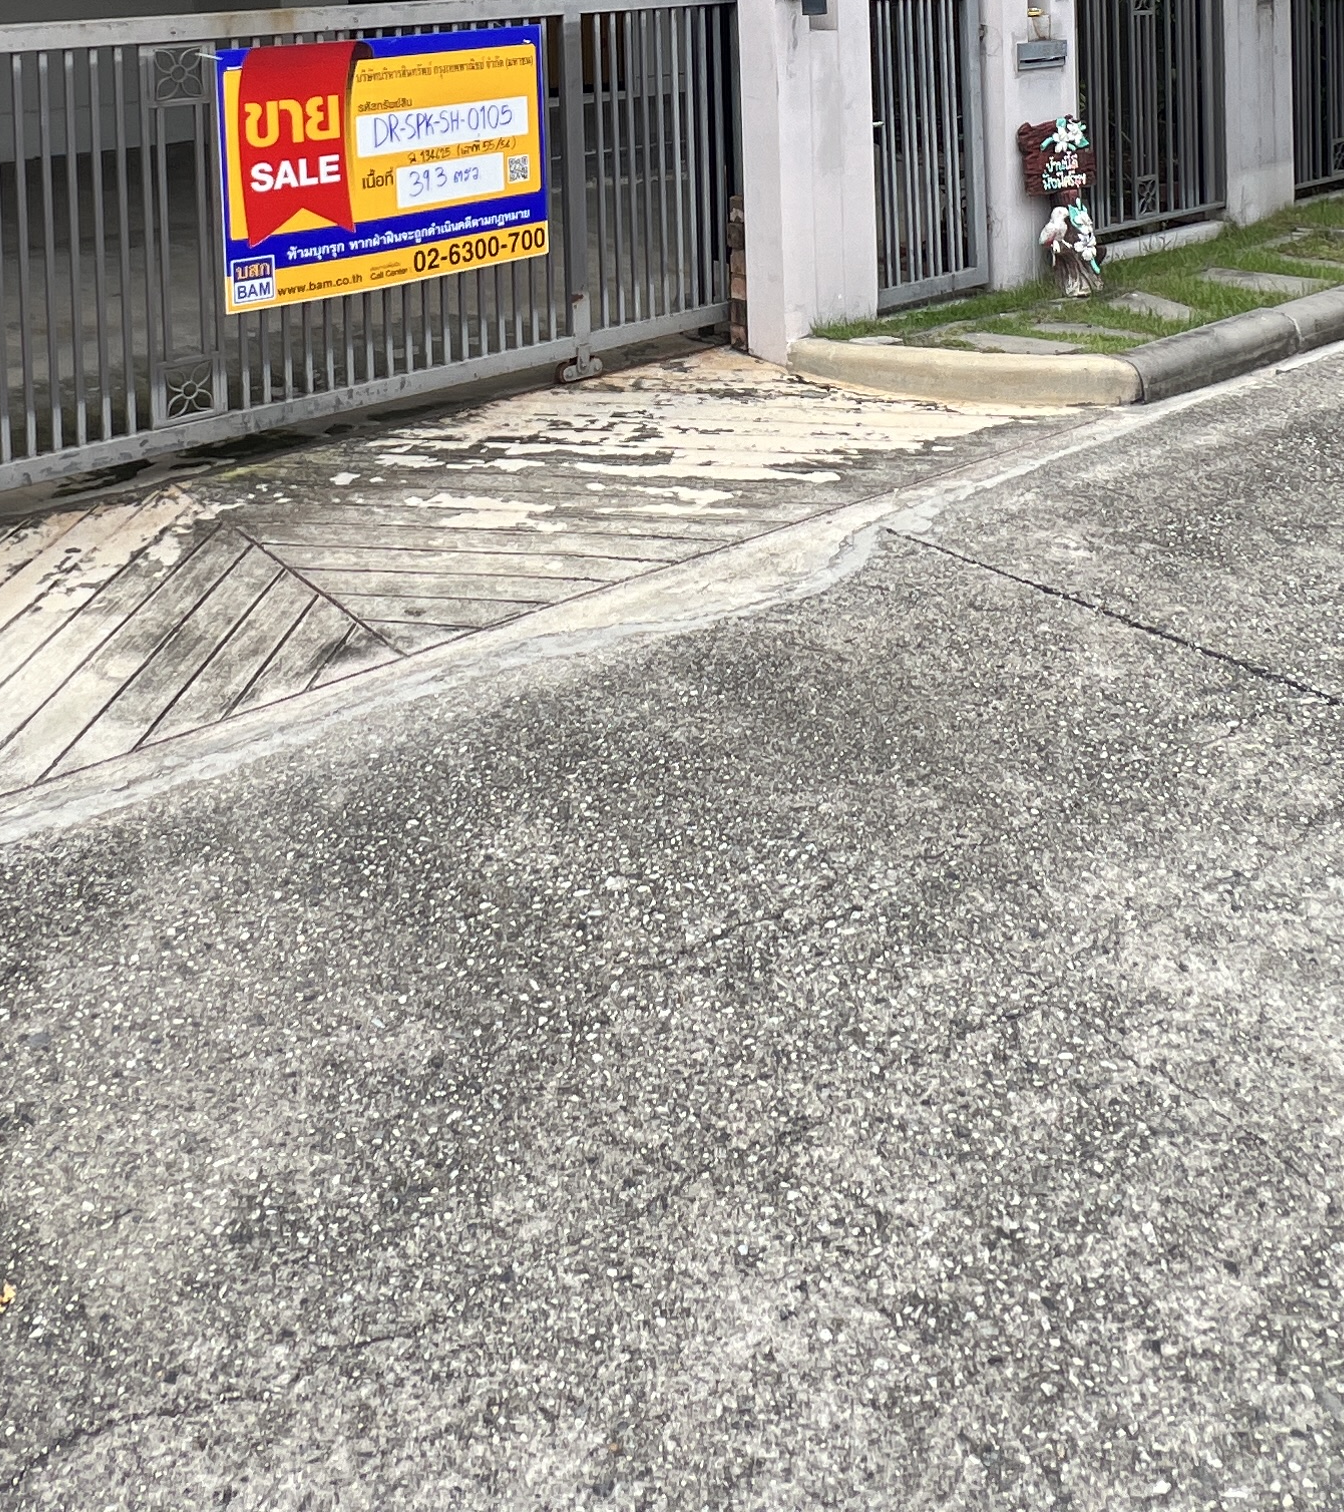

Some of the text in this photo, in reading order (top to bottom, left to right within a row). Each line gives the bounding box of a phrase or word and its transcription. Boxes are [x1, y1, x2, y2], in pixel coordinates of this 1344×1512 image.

[244, 95, 341, 148] ขาย
[373, 105, 513, 148] DR-SPK-SH-0105
[250, 154, 342, 192] SALE
[362, 166, 394, 189] เนื้อที่
[287, 241, 345, 261] ห้ามบุกรุก
[413, 227, 546, 273] 02-6300-700
[236, 262, 271, 281] บสก
[370, 271, 384, 280] Call
[237, 281, 271, 300] BAM
[277, 274, 363, 297] www.bam.co.th
